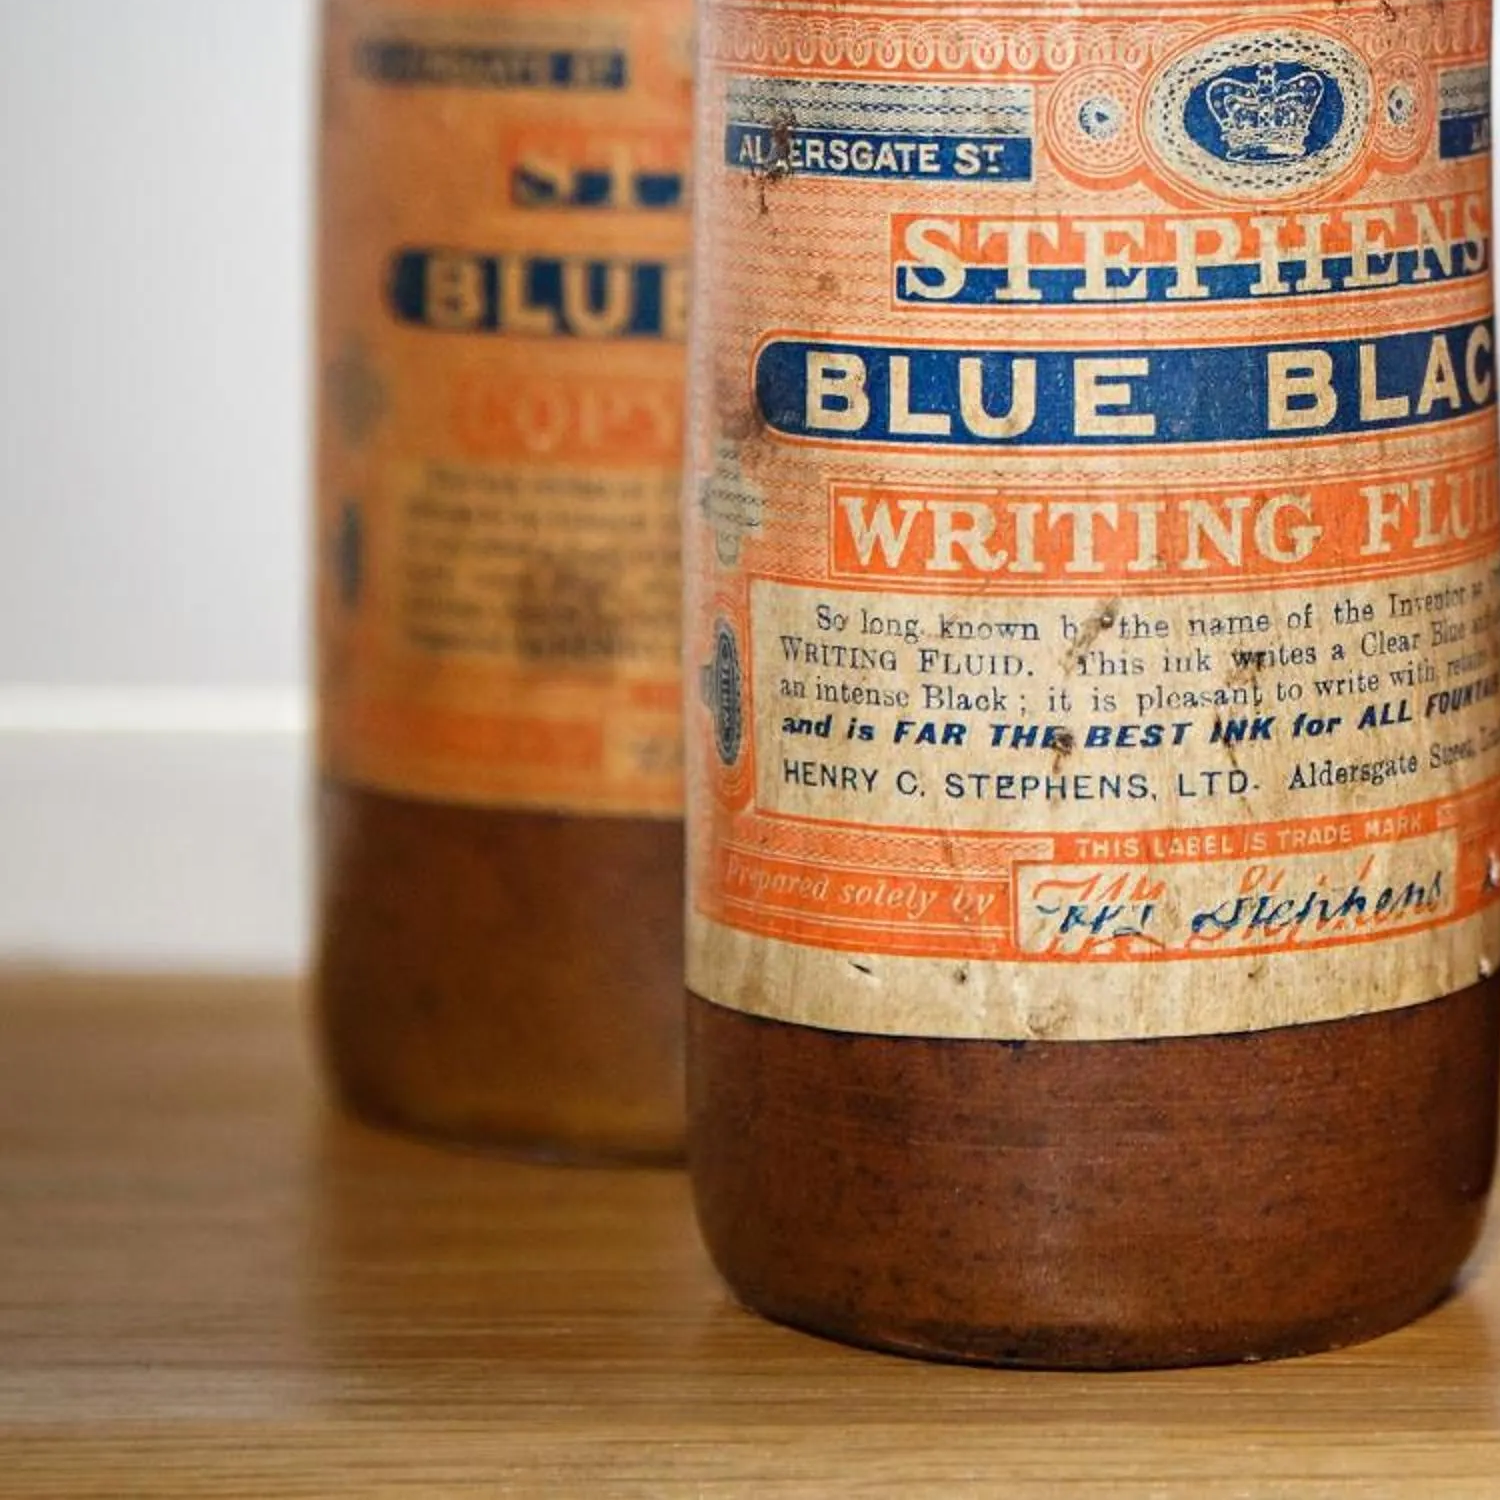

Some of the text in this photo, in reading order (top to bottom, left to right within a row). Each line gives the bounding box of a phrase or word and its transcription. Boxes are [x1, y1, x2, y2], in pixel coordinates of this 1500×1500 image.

[739, 135, 941, 172] ALERSGATE
[902, 199, 1486, 301] STEPHENS
[421, 252, 688, 337] BLU
[805, 326, 1493, 438] BLUE BLAC
[838, 490, 1322, 577] WRITING
[816, 604, 846, 631] So
[861, 608, 921, 644] long
[940, 614, 1040, 640] known
[1119, 615, 1169, 640] the
[1189, 613, 1269, 637] name
[1288, 603, 1312, 630] of
[1334, 600, 1374, 624] the
[1389, 585, 1465, 618] Inventor
[779, 636, 897, 672] WRITING
[918, 649, 1034, 676] FLUID.
[1077, 651, 1144, 676] This
[1163, 648, 1211, 672] ink
[1232, 644, 1316, 668] writes
[1332, 643, 1345, 661] a
[1361, 631, 1420, 657] Clear
[1432, 620, 1465, 647] Blue
[780, 677, 805, 698] an
[816, 676, 909, 707] intense
[1048, 687, 1072, 712] it
[1092, 687, 1117, 712] is
[1136, 685, 1262, 716] pleasant
[1277, 681, 1303, 702] to
[1314, 670, 1380, 696] write
[782, 714, 833, 738] and
[847, 717, 875, 741] is
[893, 720, 967, 746] FAR
[990, 724, 1067, 749] THE
[1084, 722, 1192, 748] BEST
[1210, 714, 1276, 744] INK
[1292, 712, 1342, 737] for
[1358, 700, 1412, 730] ALL
[782, 759, 878, 793] HENRY
[897, 770, 925, 797] C.
[945, 772, 1157, 801] STEPHENS,
[1179, 769, 1260, 797] LTD.
[1289, 753, 1417, 790] Aldersgate
[1076, 814, 1425, 859] THIS LABEL IS TRADE MARK
[727, 853, 828, 900] Prepared
[840, 879, 937, 920] solely
[952, 884, 994, 922] by
